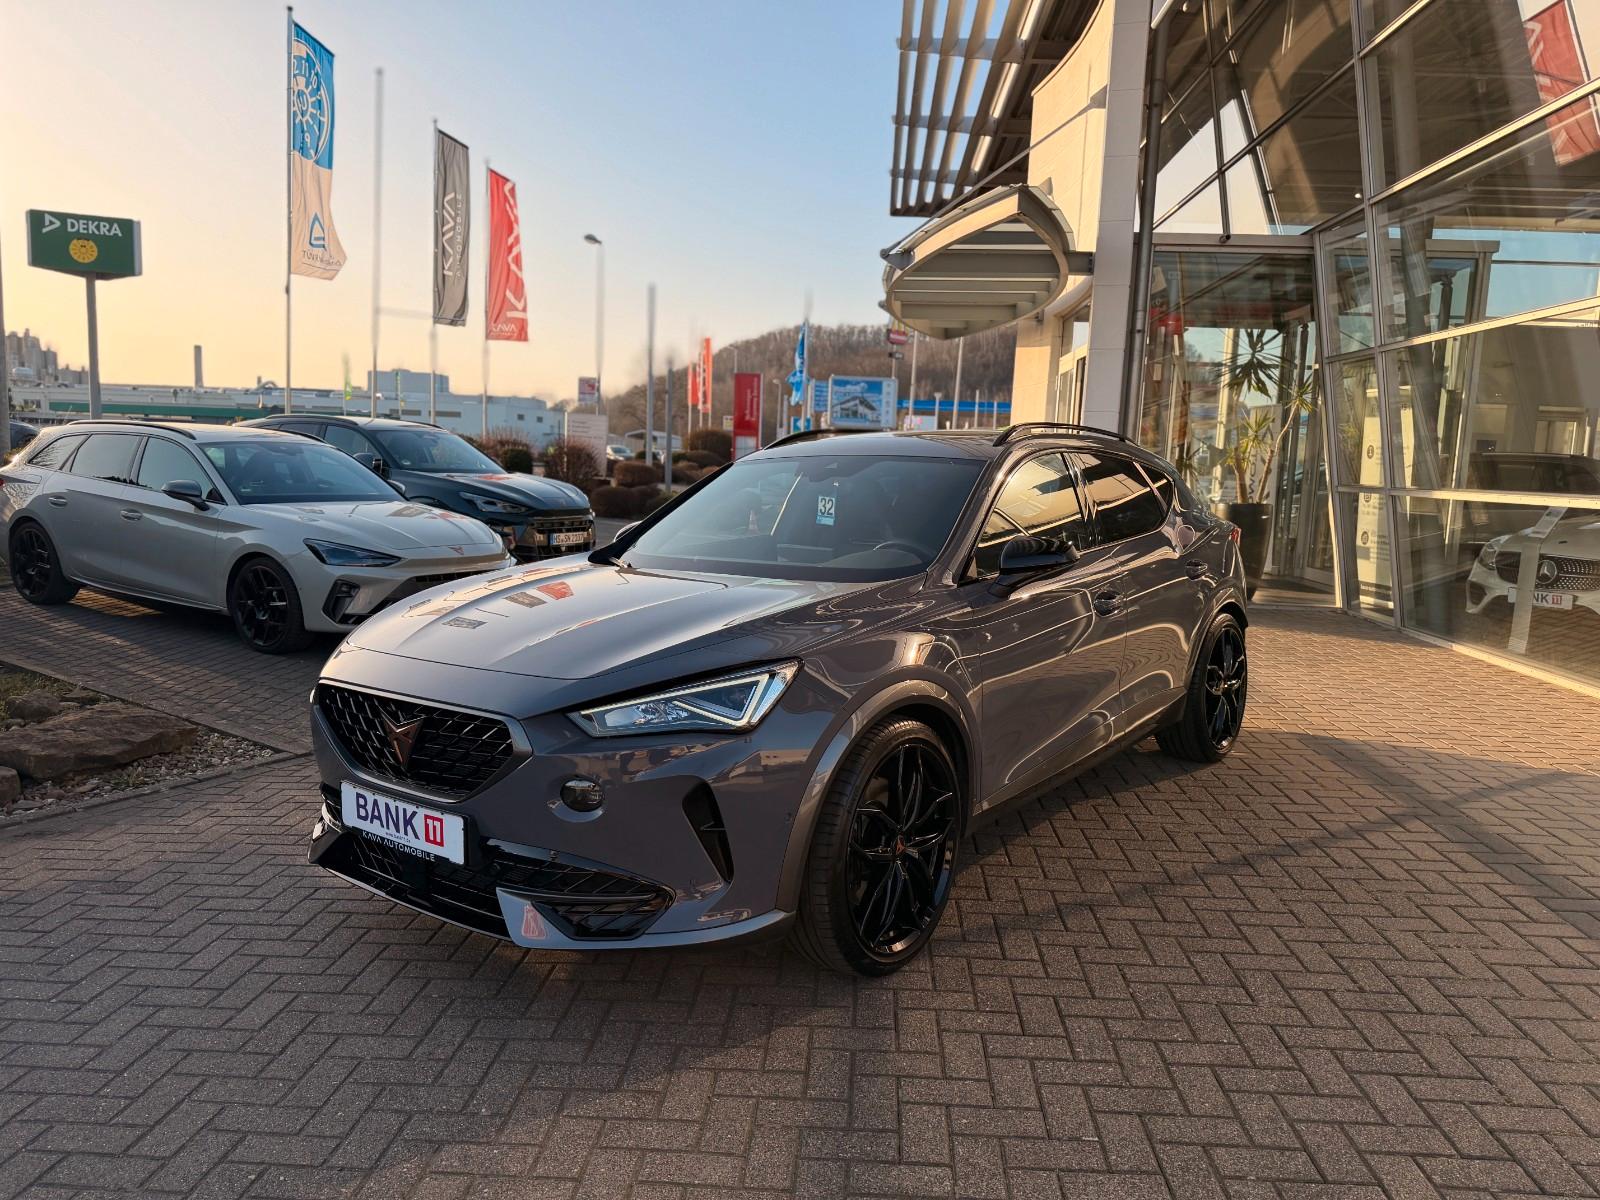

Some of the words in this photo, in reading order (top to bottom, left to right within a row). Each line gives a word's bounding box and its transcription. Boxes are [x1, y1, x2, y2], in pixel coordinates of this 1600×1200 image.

[67, 218, 122, 237] DEKRA
[442, 191, 455, 276] KAVA
[504, 181, 528, 319] KAVA
[819, 497, 834, 516] 32
[355, 791, 420, 840] BANK
[426, 817, 442, 844] 11
[362, 830, 382, 844] KAVA
[383, 839, 435, 862] AUTOMOBILE
